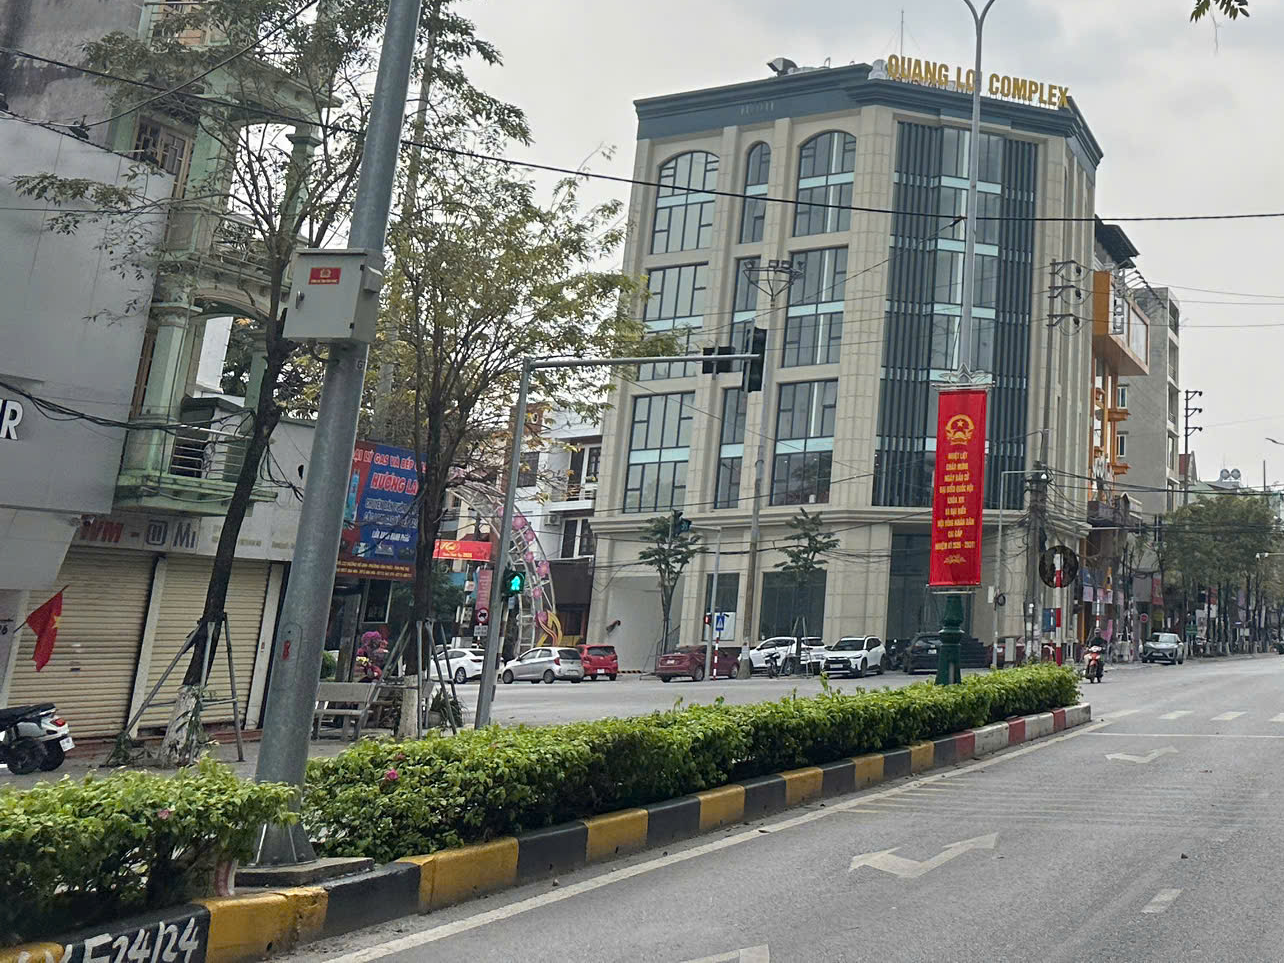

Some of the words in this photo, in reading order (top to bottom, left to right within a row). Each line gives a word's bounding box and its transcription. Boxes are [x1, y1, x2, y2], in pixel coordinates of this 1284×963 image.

[888, 54, 948, 86] QUANG
[956, 66, 982, 92] LO
[989, 73, 1069, 107] COMPLEX
[0, 398, 23, 440] R
[374, 453, 389, 466] GAS
